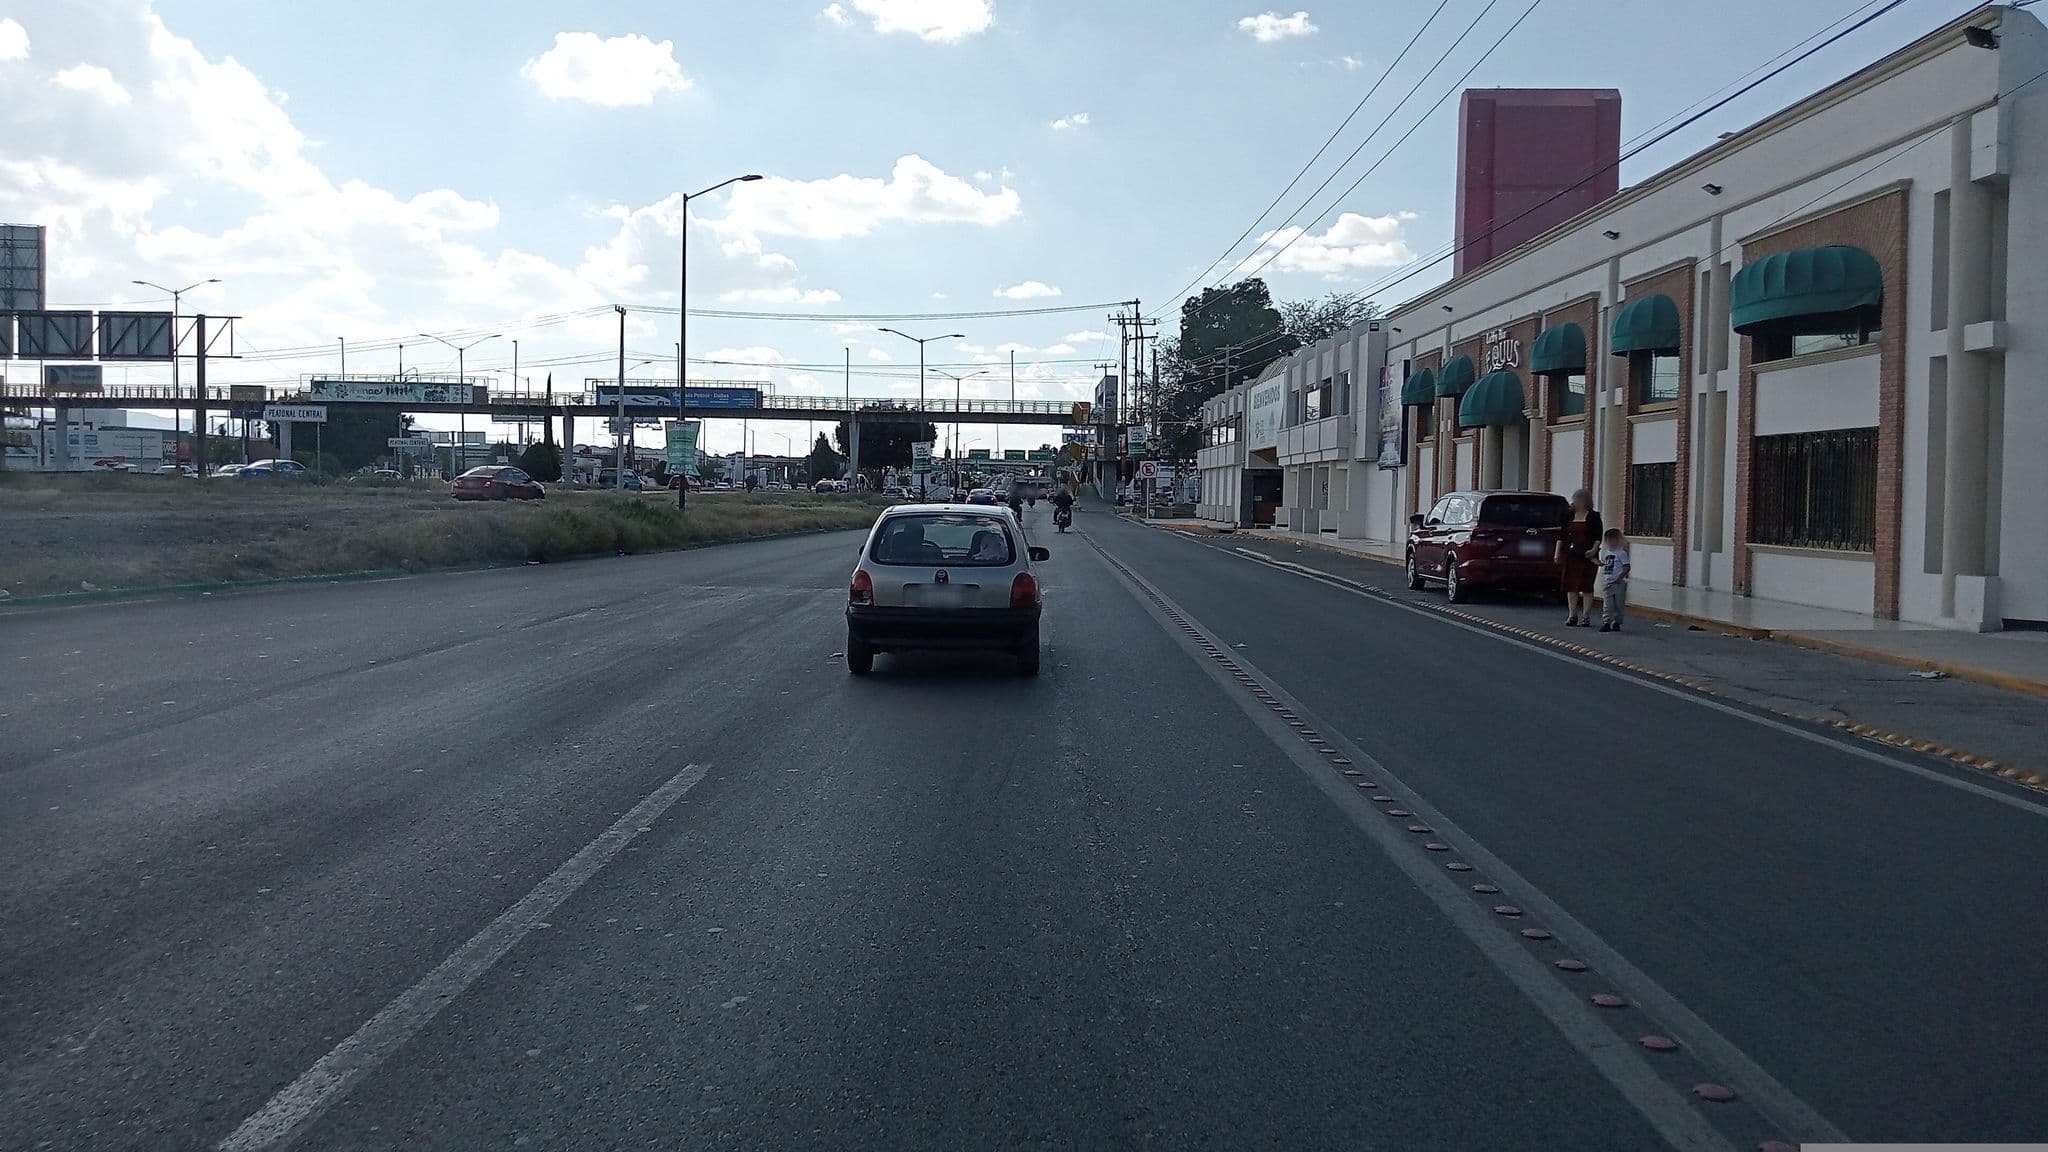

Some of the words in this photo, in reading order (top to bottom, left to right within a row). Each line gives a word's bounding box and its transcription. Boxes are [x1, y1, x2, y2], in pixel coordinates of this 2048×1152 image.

[1486, 340, 1520, 373] EQUUS
[1254, 384, 1281, 409] BIENVENIDOS
[299, 411, 323, 419] CENTRAL
[1145, 464, 1153, 473] E
